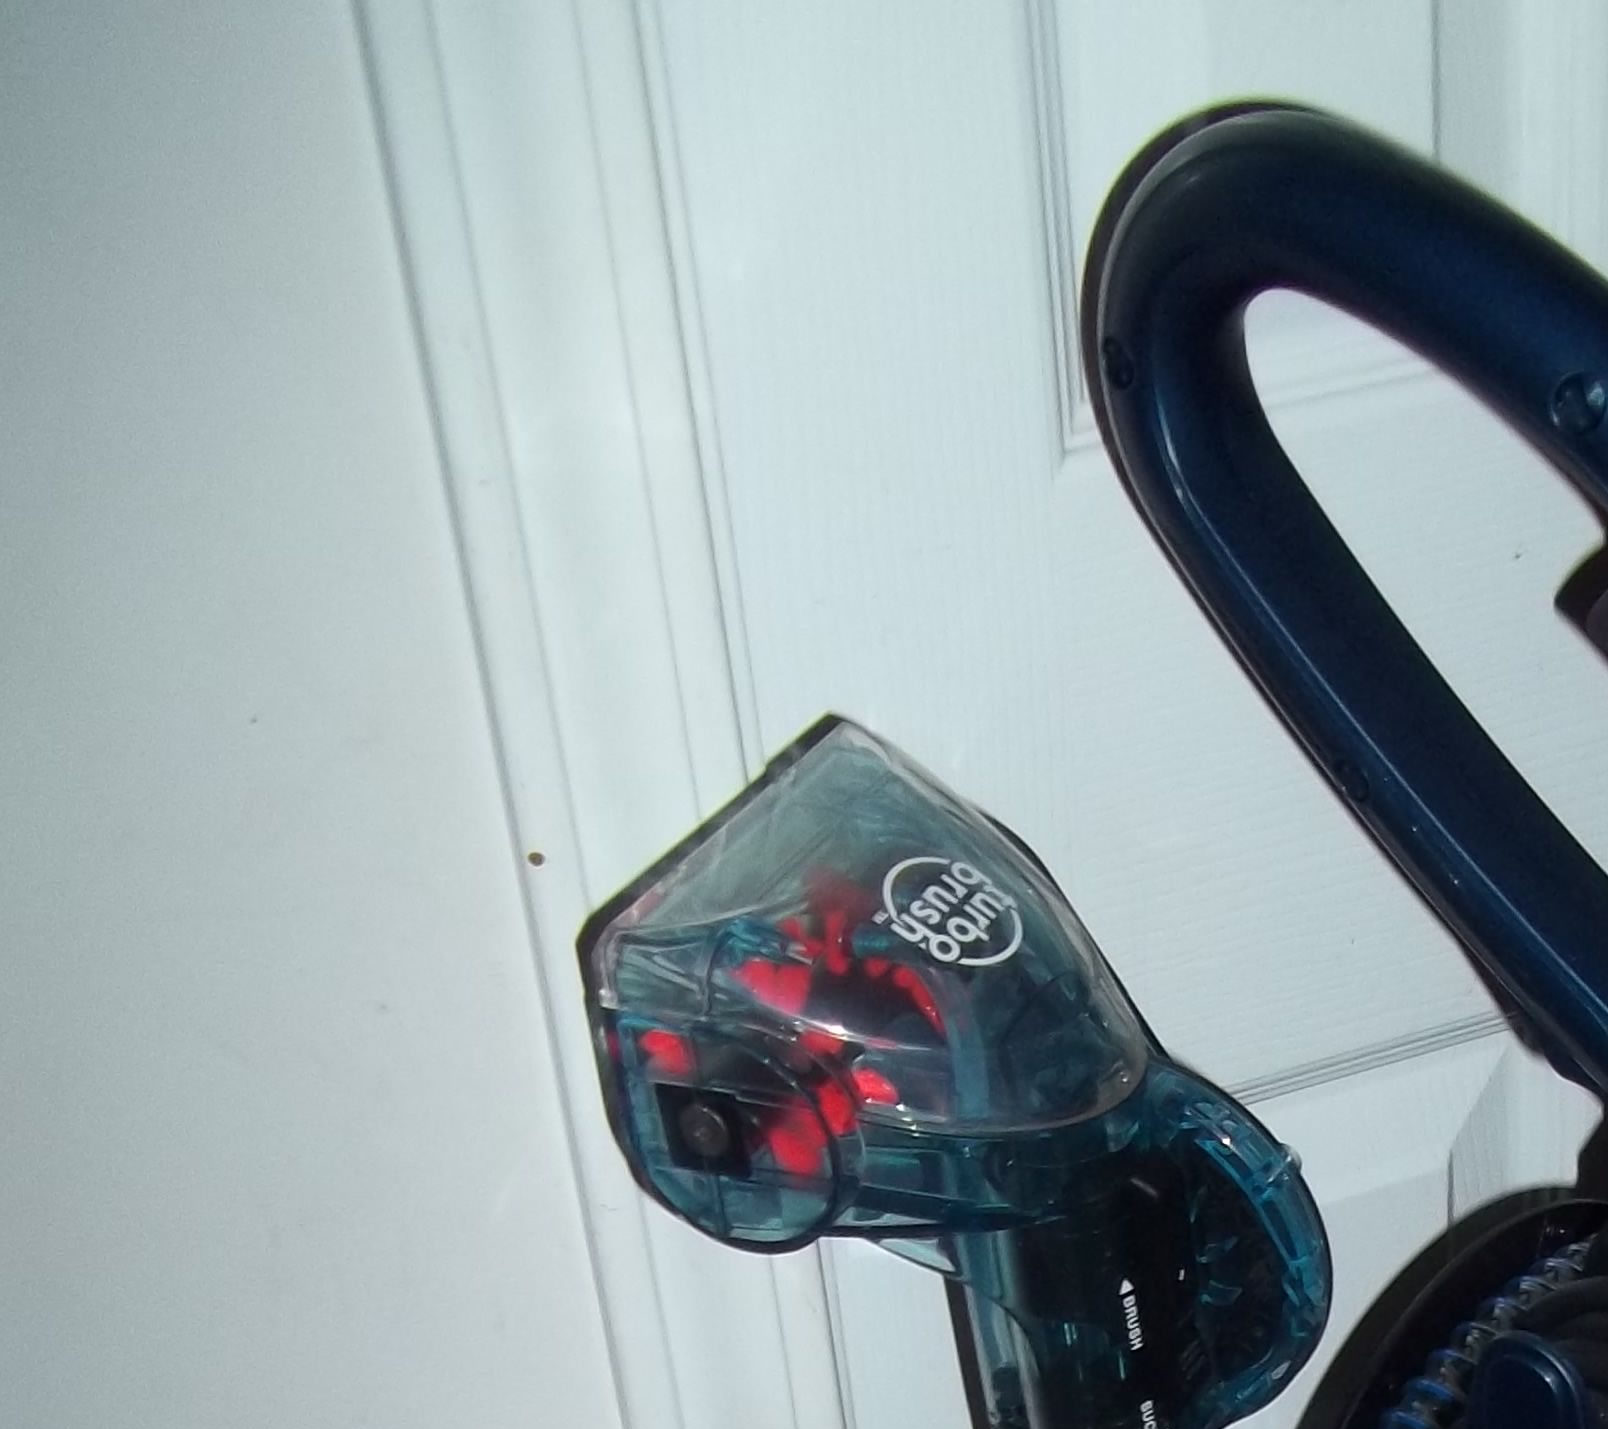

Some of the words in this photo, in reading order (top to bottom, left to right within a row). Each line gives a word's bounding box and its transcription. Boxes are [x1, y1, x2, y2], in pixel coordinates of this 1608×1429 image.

[890, 862, 992, 942] brush
[929, 884, 1018, 962] turbo
[1122, 1294, 1144, 1350] BRUSH
